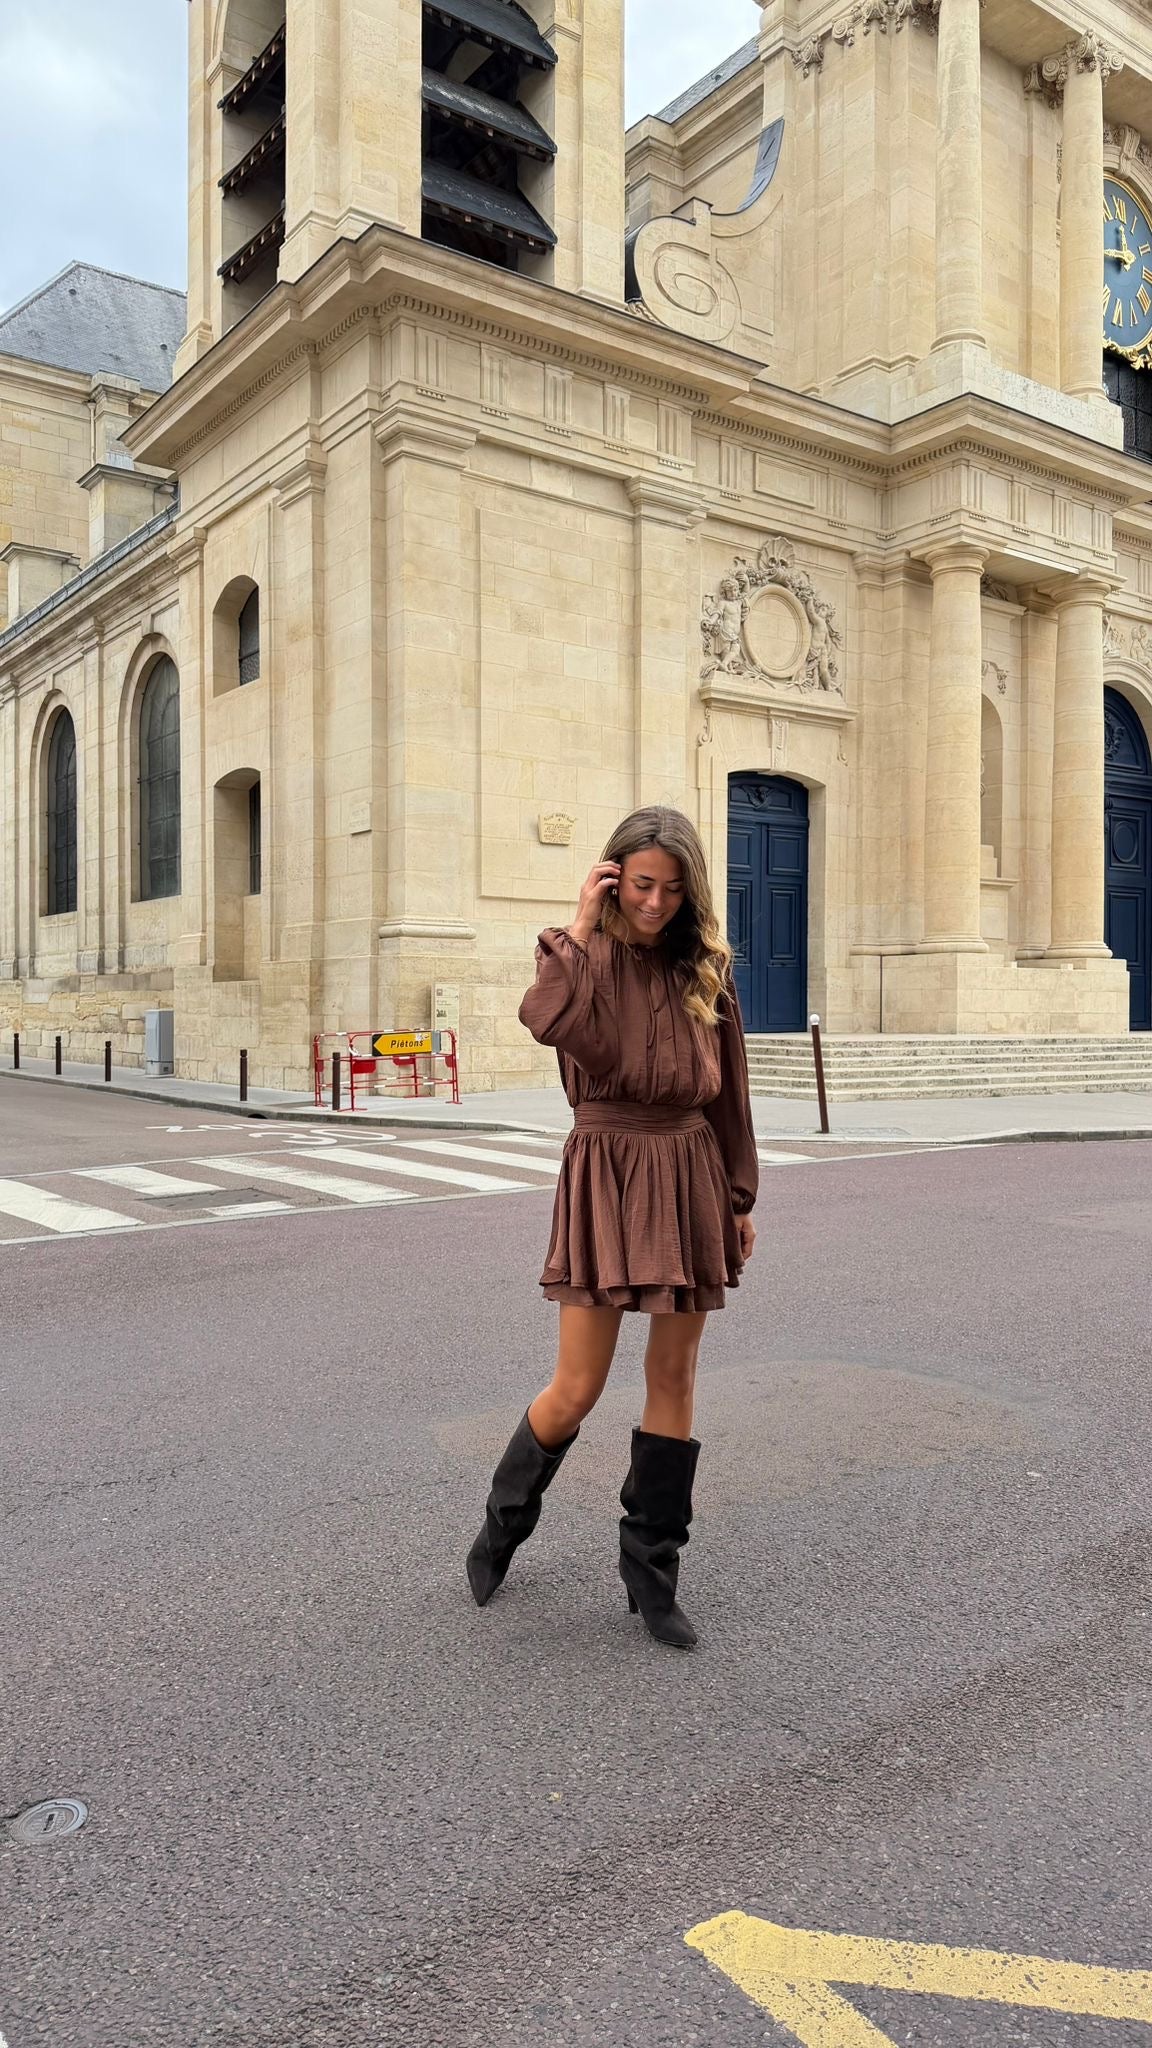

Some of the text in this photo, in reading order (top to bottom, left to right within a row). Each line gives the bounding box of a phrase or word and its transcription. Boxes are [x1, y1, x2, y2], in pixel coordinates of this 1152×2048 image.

[1112, 194, 1127, 224] XII
[390, 1039, 424, 1048] Piétons
[144, 1123, 338, 1133] ZONE
[248, 1128, 397, 1145] 30
